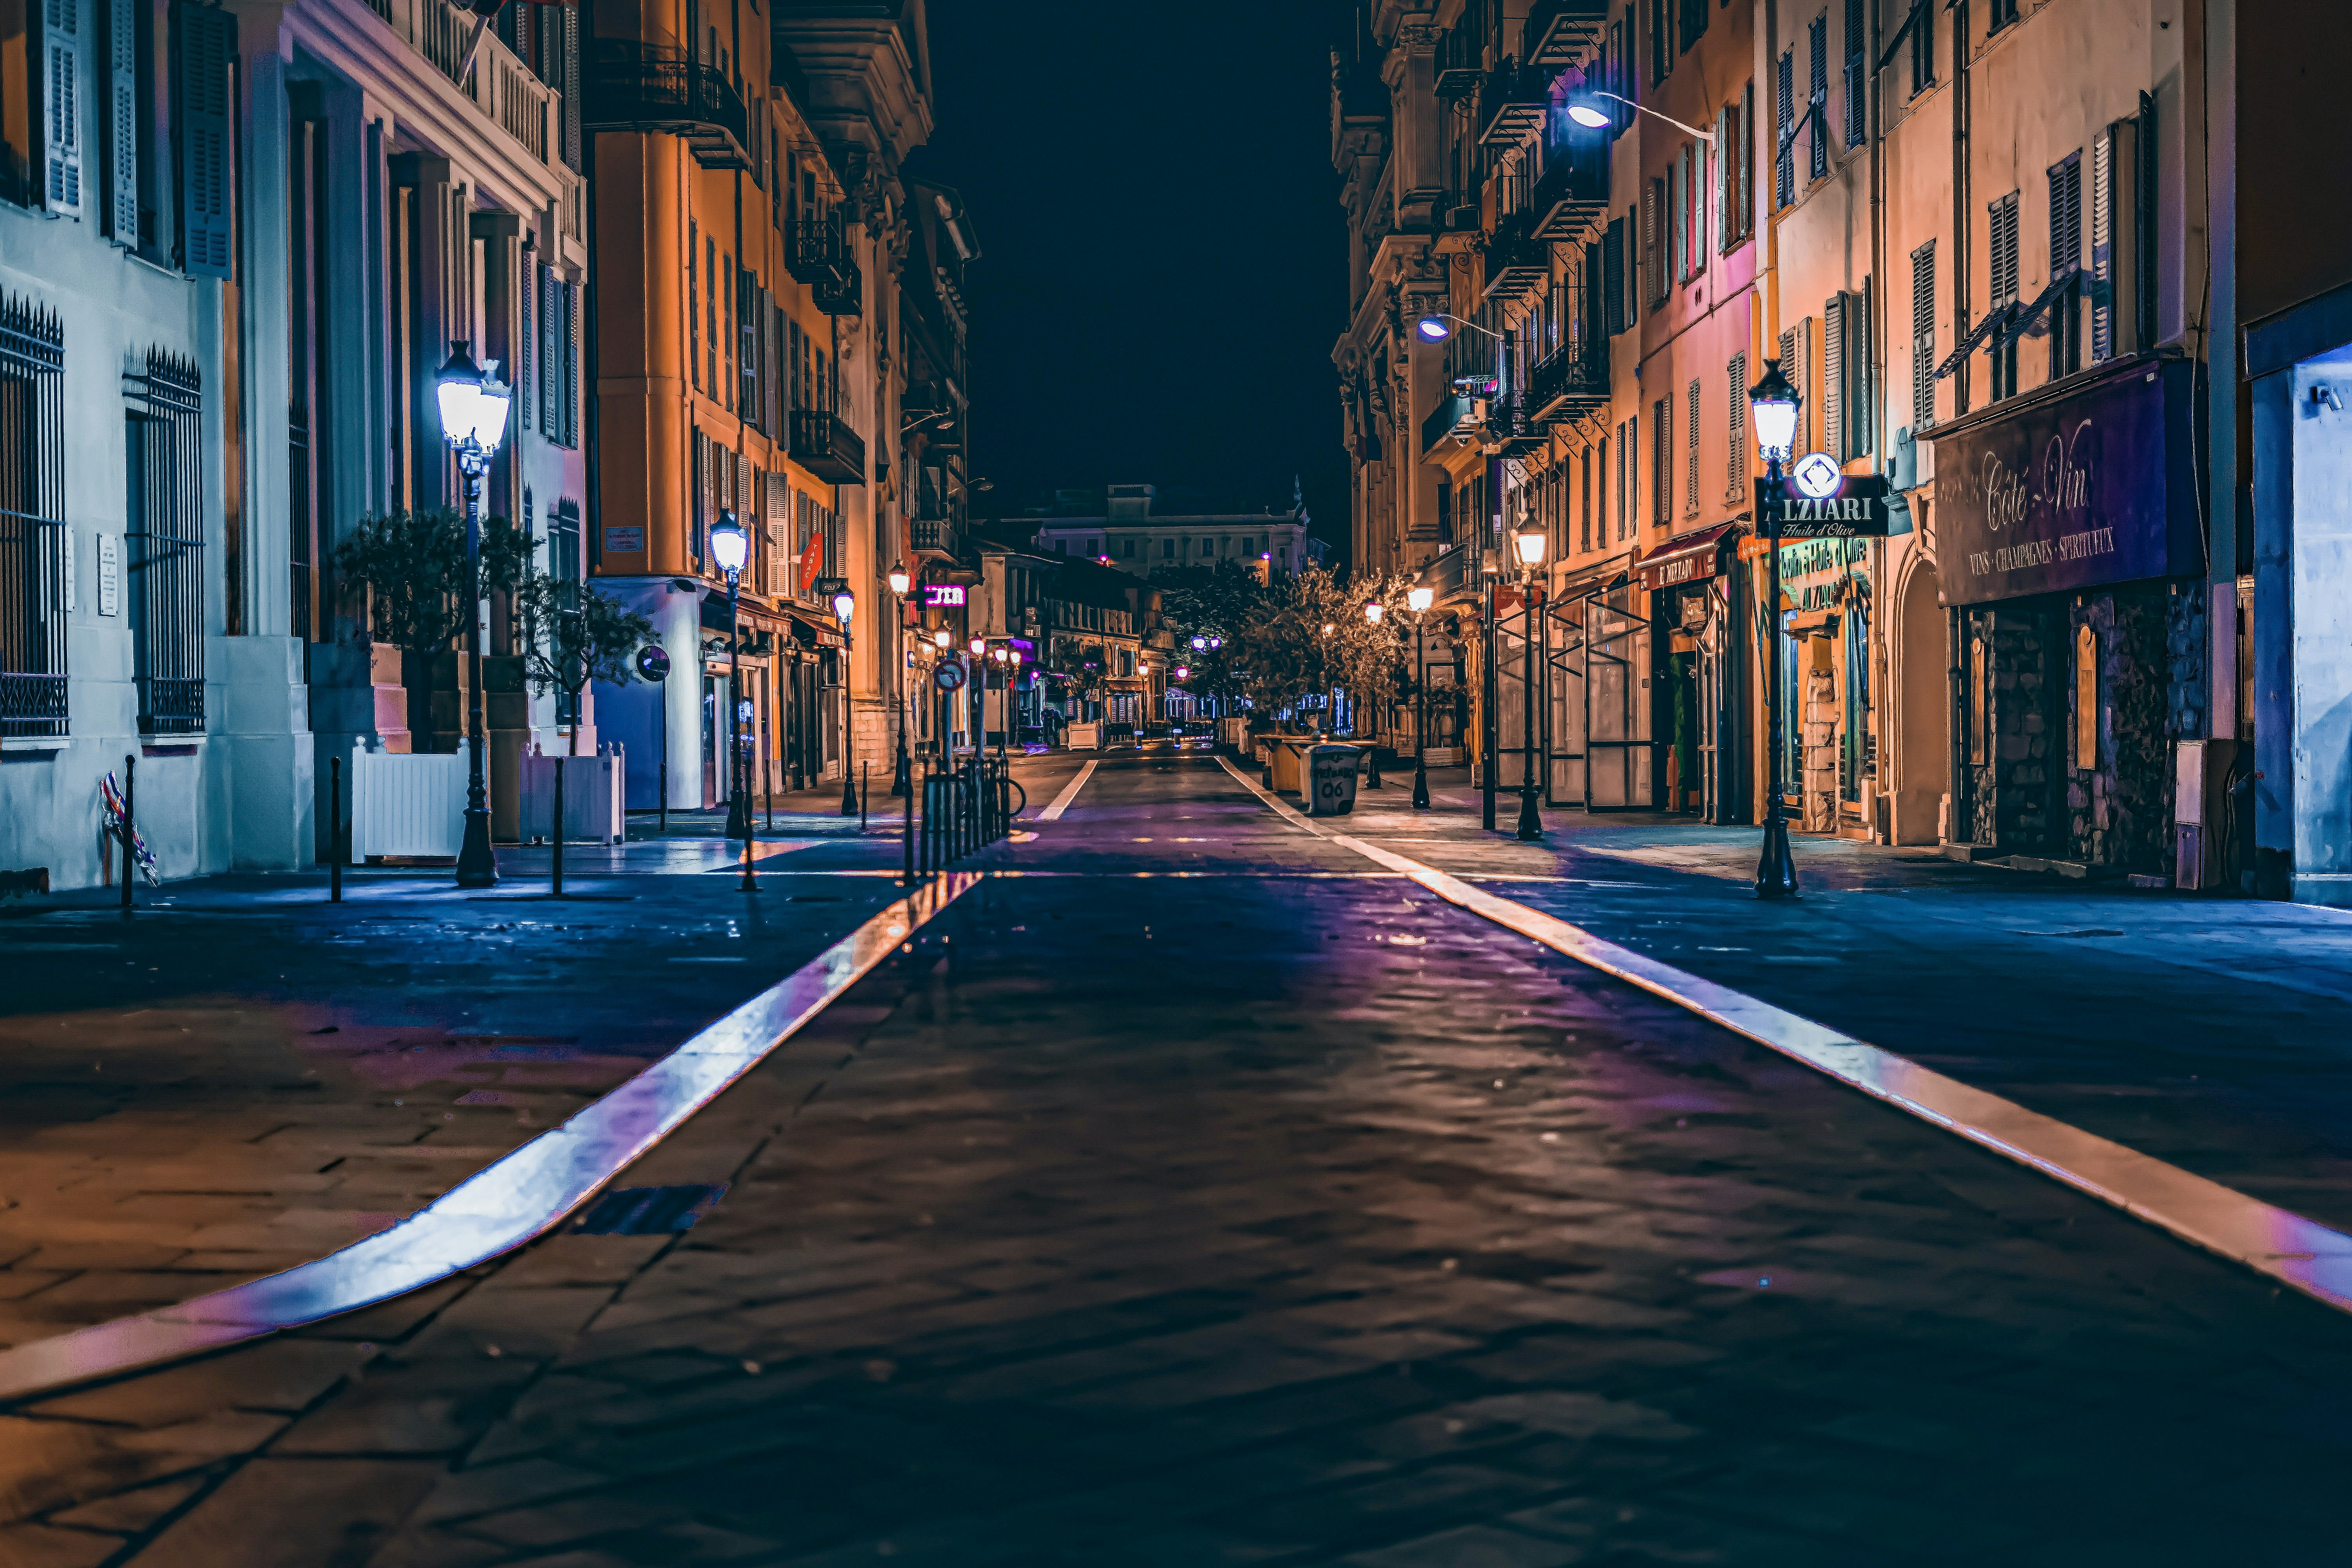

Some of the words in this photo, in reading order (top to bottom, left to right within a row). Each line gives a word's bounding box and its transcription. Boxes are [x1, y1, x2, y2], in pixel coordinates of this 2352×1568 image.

[1982, 450, 2029, 531] Côté
[2043, 418, 2092, 515] Vin
[1764, 498, 1873, 521] LZIARI
[1781, 523, 1814, 537] Huile
[1817, 523, 1855, 536] d'Olive
[805, 543, 818, 578] TABAC
[1969, 551, 1990, 576] VINS
[1996, 539, 2053, 572] CHAMPAGNES
[2059, 526, 2114, 561] SPIRITUEUX
[1321, 780, 1344, 799] 06
